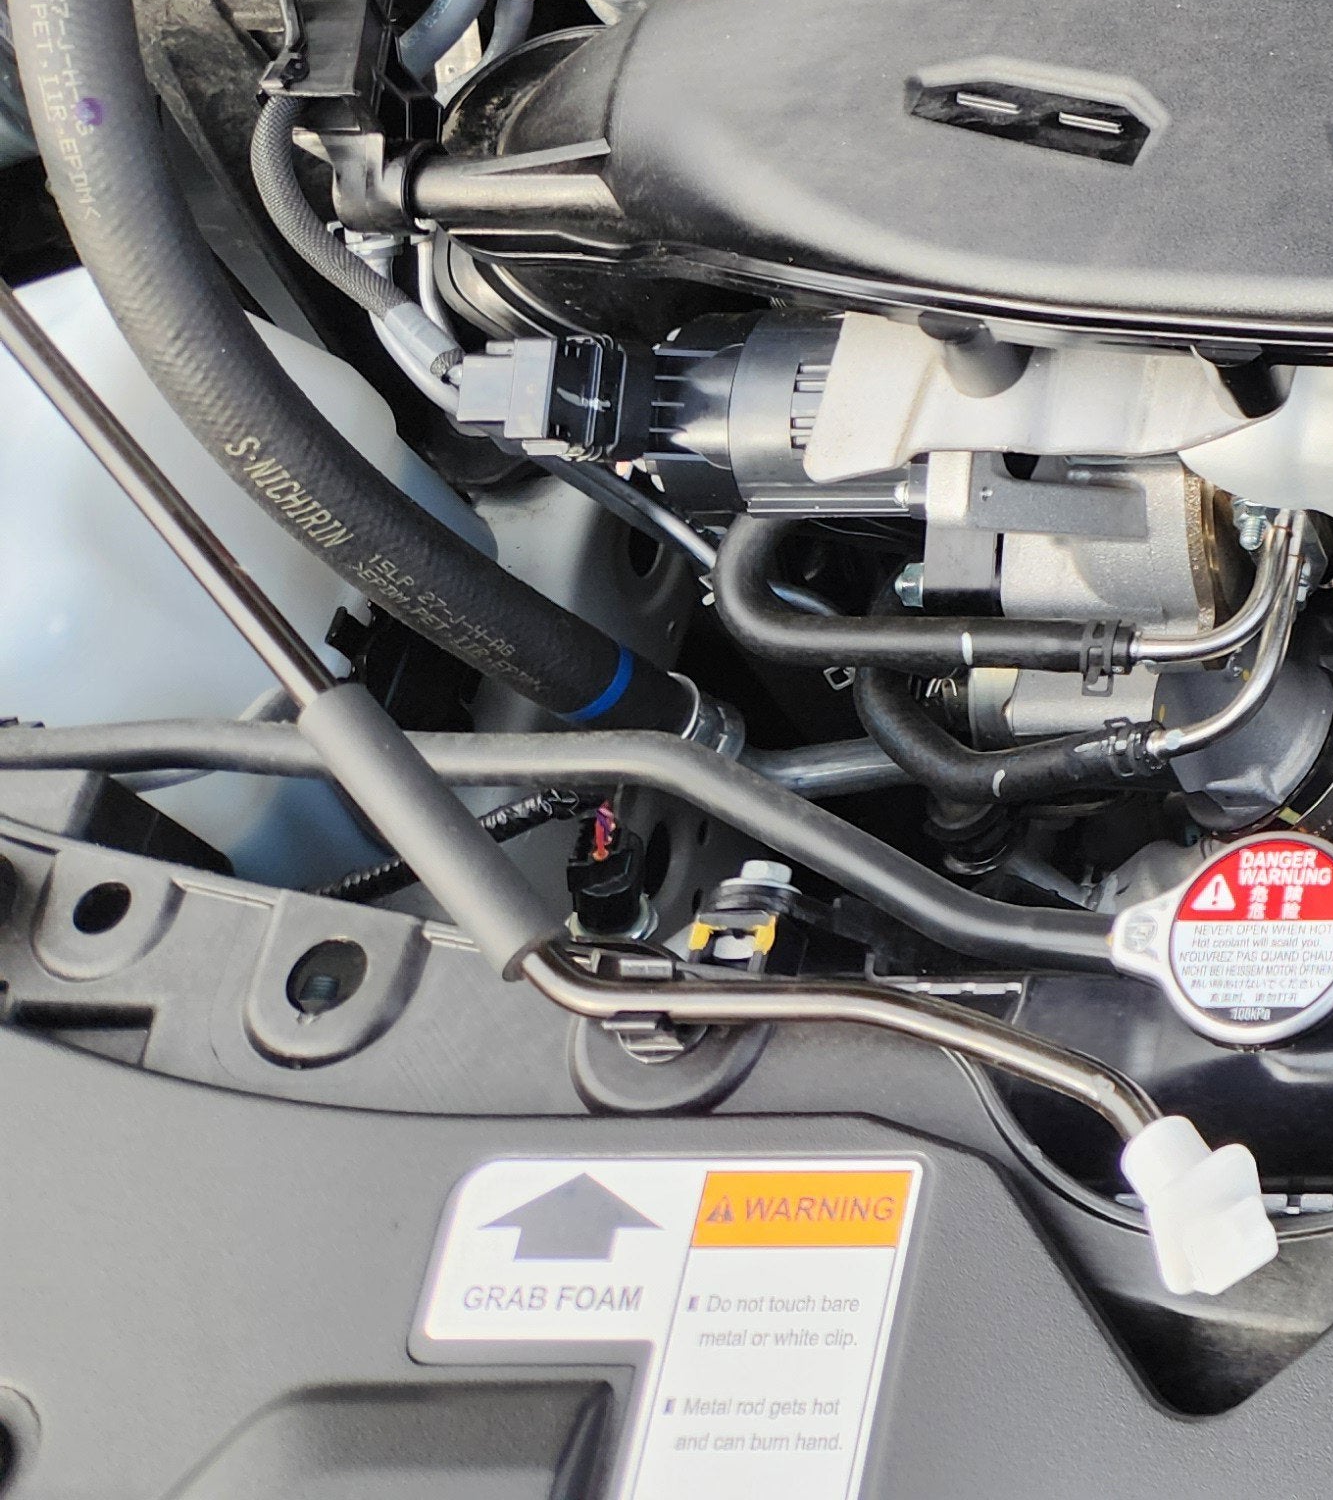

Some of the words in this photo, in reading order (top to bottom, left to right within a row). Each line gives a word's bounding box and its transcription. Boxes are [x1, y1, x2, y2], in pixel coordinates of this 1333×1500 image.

[368, 553, 415, 587] 15LP
[1239, 849, 1318, 869] DANGER
[1238, 867, 1332, 886] WARNUNG
[1194, 925, 1234, 935] NEVER
[1237, 925, 1268, 935] OPEN
[1272, 925, 1306, 935] WHEN
[1192, 938, 1210, 948] Hot
[1213, 938, 1249, 947] coolant
[1252, 938, 1268, 947] will
[1271, 938, 1298, 947] scald
[1236, 952, 1258, 962] PAS
[1260, 952, 1299, 962] QUAND
[1181, 966, 1207, 976] NICHT
[1209, 966, 1224, 976] BEI
[1225, 966, 1263, 976] HEISSEM
[1265, 966, 1297, 976] MOTOR
[745, 1196, 896, 1223] WARNING
[462, 1286, 548, 1311] GRAB
[555, 1286, 645, 1311] FOAM
[706, 1296, 731, 1313] Do
[736, 1297, 763, 1313] not
[768, 1295, 817, 1313] touch
[821, 1295, 861, 1313] bare
[699, 1330, 747, 1347] metal
[751, 1333, 771, 1347] or
[774, 1330, 820, 1347] white
[825, 1330, 858, 1349] clip.
[684, 1399, 732, 1417] Metal
[736, 1399, 766, 1417] rod
[770, 1401, 807, 1421] gets
[811, 1399, 840, 1417] hot
[674, 1434, 709, 1452] and
[713, 1437, 746, 1452] can
[750, 1434, 792, 1452] burn
[795, 1434, 843, 1452] hand.
